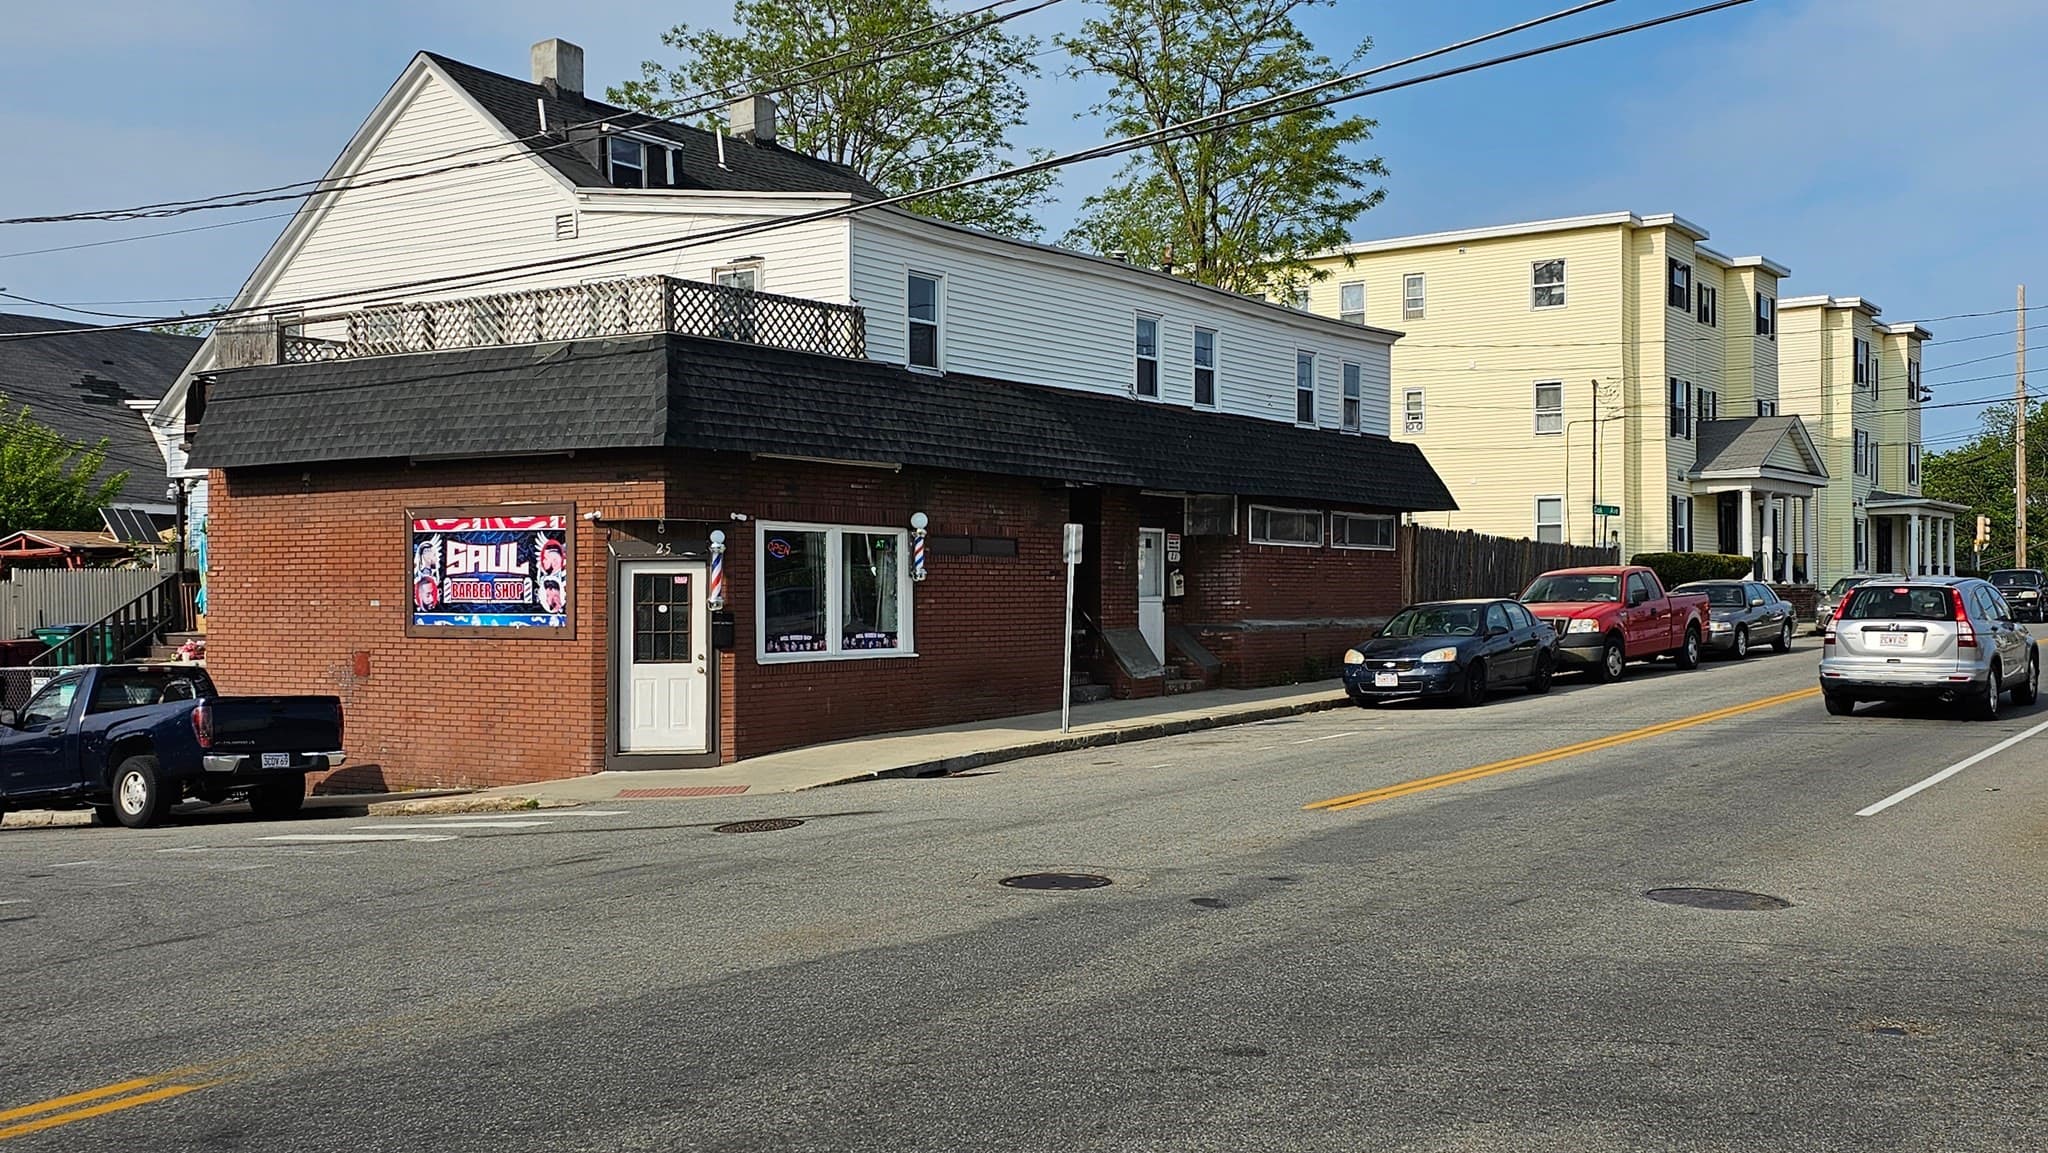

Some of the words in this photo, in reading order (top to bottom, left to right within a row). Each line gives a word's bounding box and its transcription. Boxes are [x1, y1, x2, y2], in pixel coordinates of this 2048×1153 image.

[656, 542, 671, 555] 25
[767, 541, 790, 556] OPEN
[446, 540, 529, 575] SAUL
[452, 582, 492, 599] BARBER
[495, 582, 524, 599] SHOP
